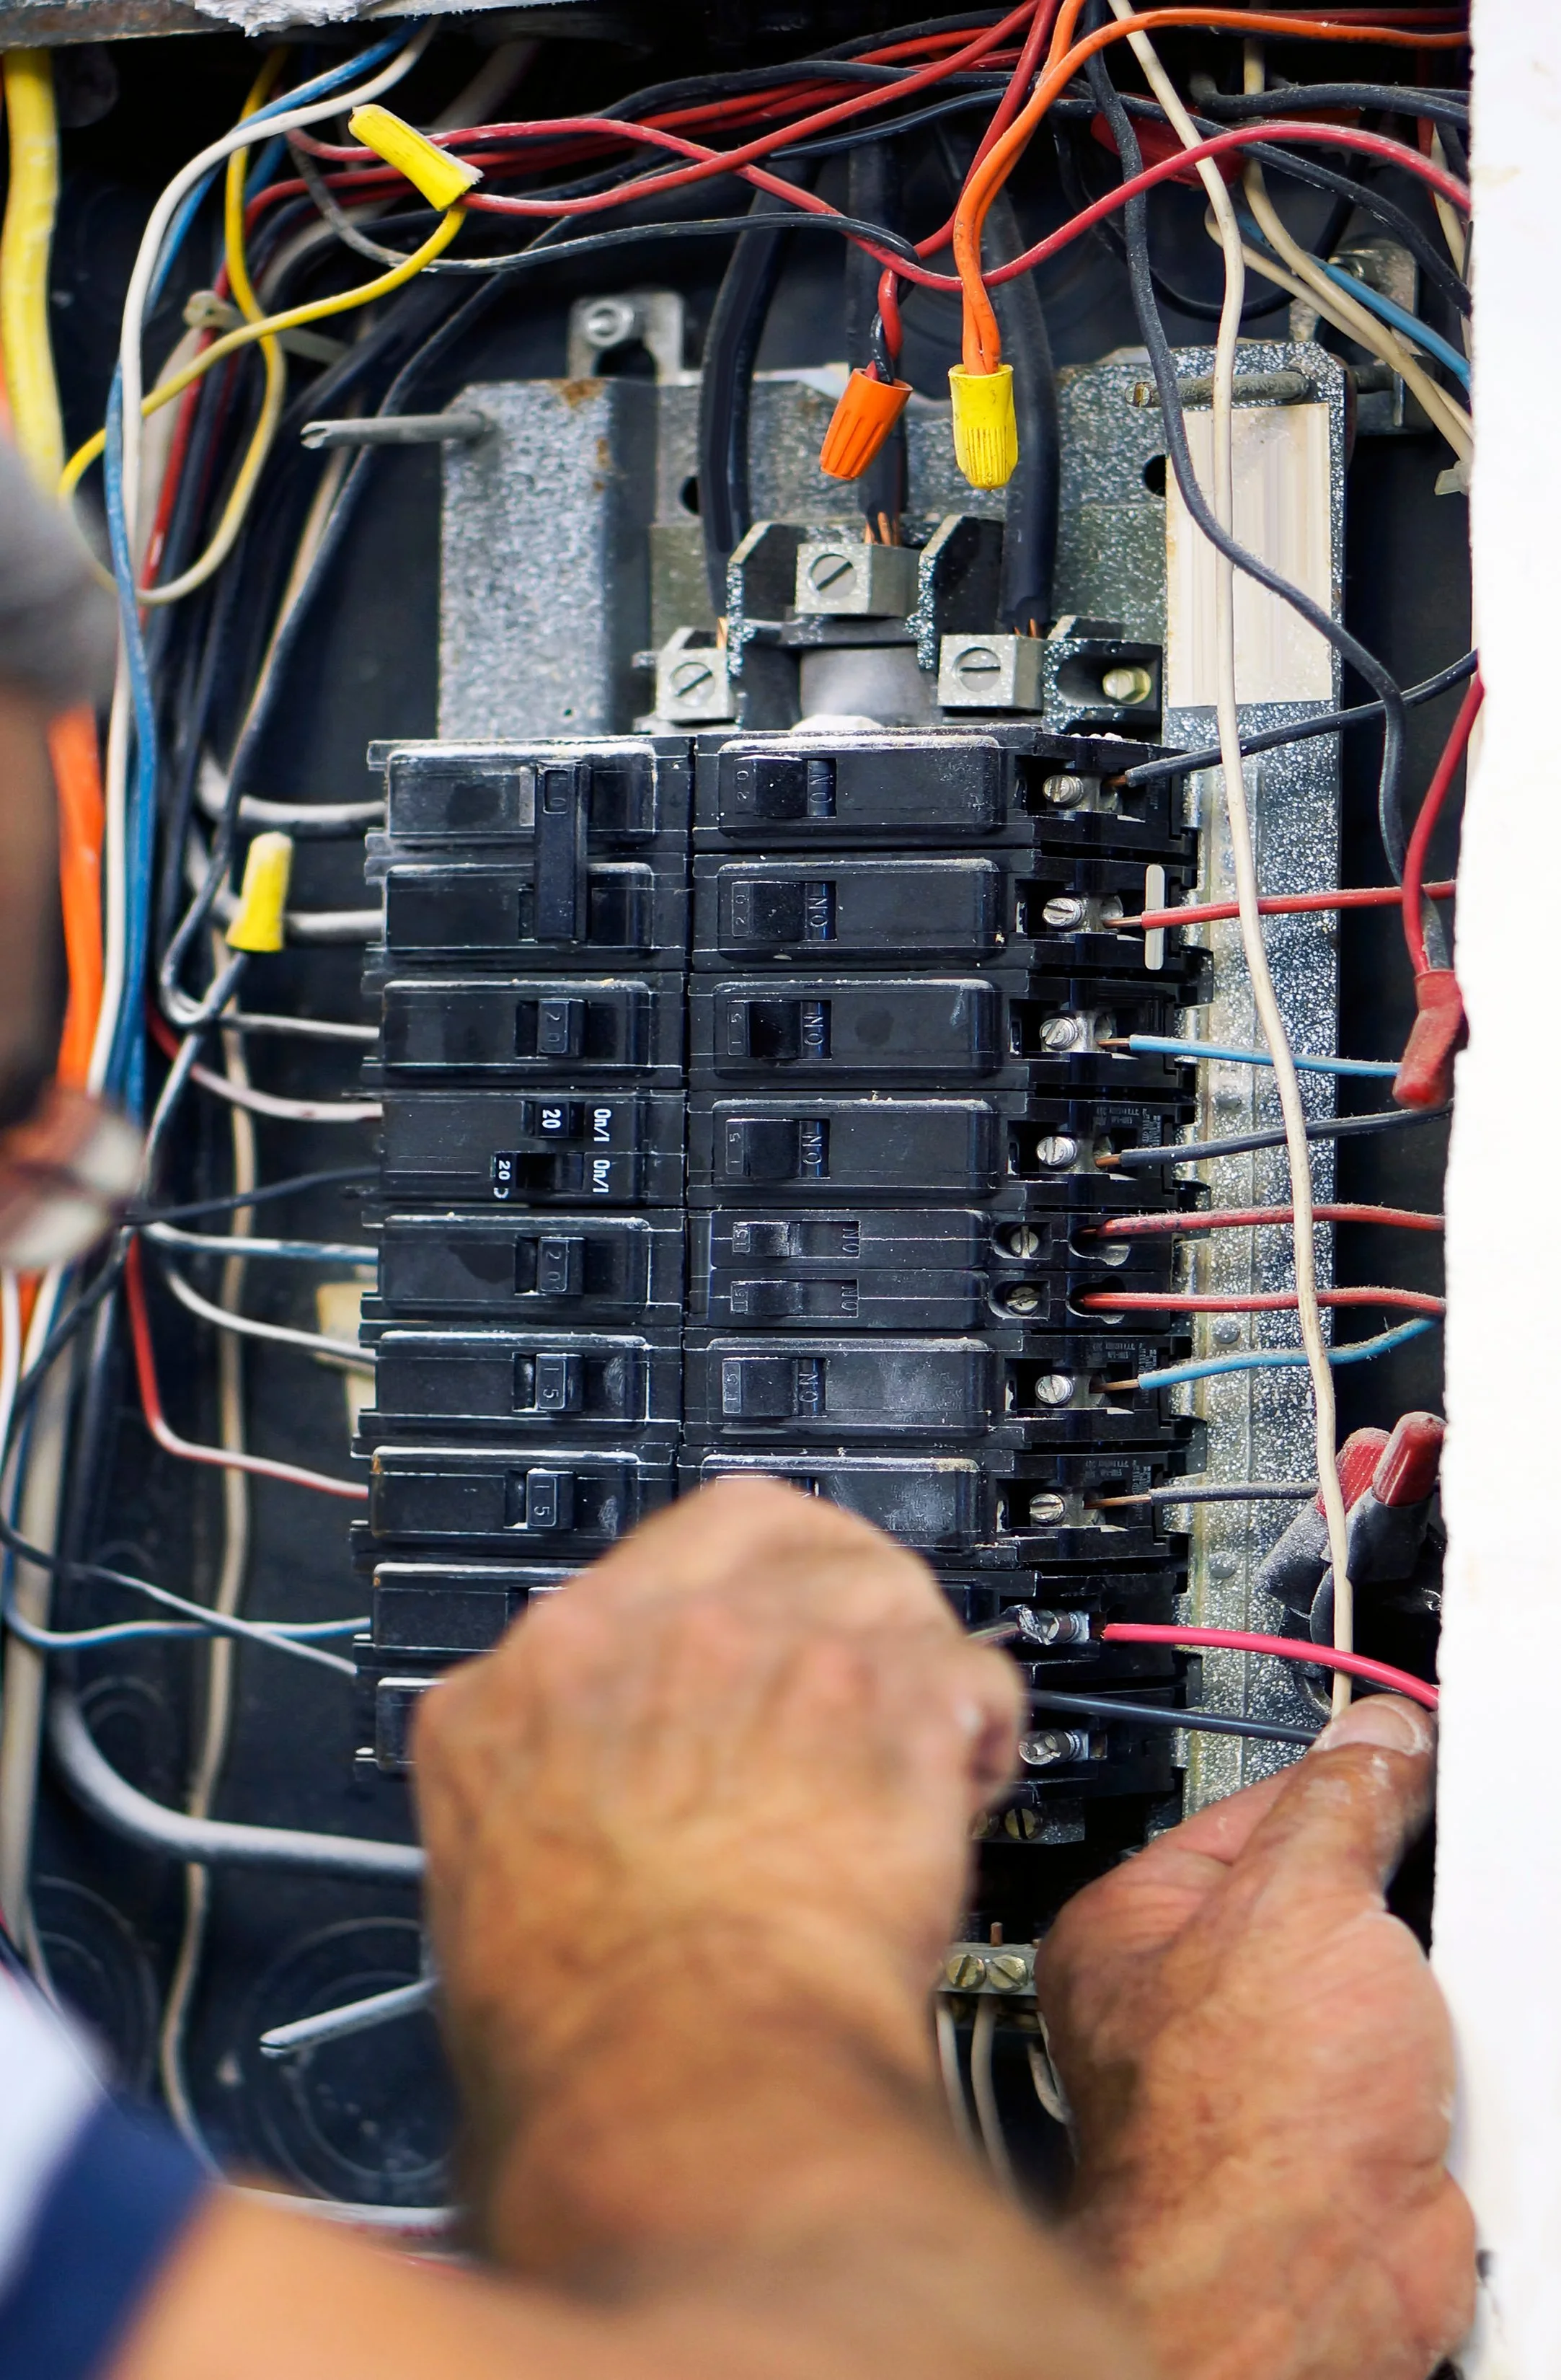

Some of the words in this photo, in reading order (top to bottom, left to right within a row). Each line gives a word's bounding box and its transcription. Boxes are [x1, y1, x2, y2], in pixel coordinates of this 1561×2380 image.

[808, 774, 833, 803] ON
[808, 897, 828, 928] ON
[730, 1013, 743, 1044] 15
[802, 1013, 824, 1046] ON
[541, 1109, 562, 1129] 20
[729, 1132, 741, 1164] 15
[801, 1133, 823, 1165] ON
[498, 1160, 511, 1181] 20
[842, 1228, 860, 1253] ON
[546, 1250, 562, 1282] 20
[841, 1286, 859, 1311] ON
[542, 1367, 560, 1398] 15
[798, 1372, 819, 1403] ON
[534, 1485, 550, 1516] 15
